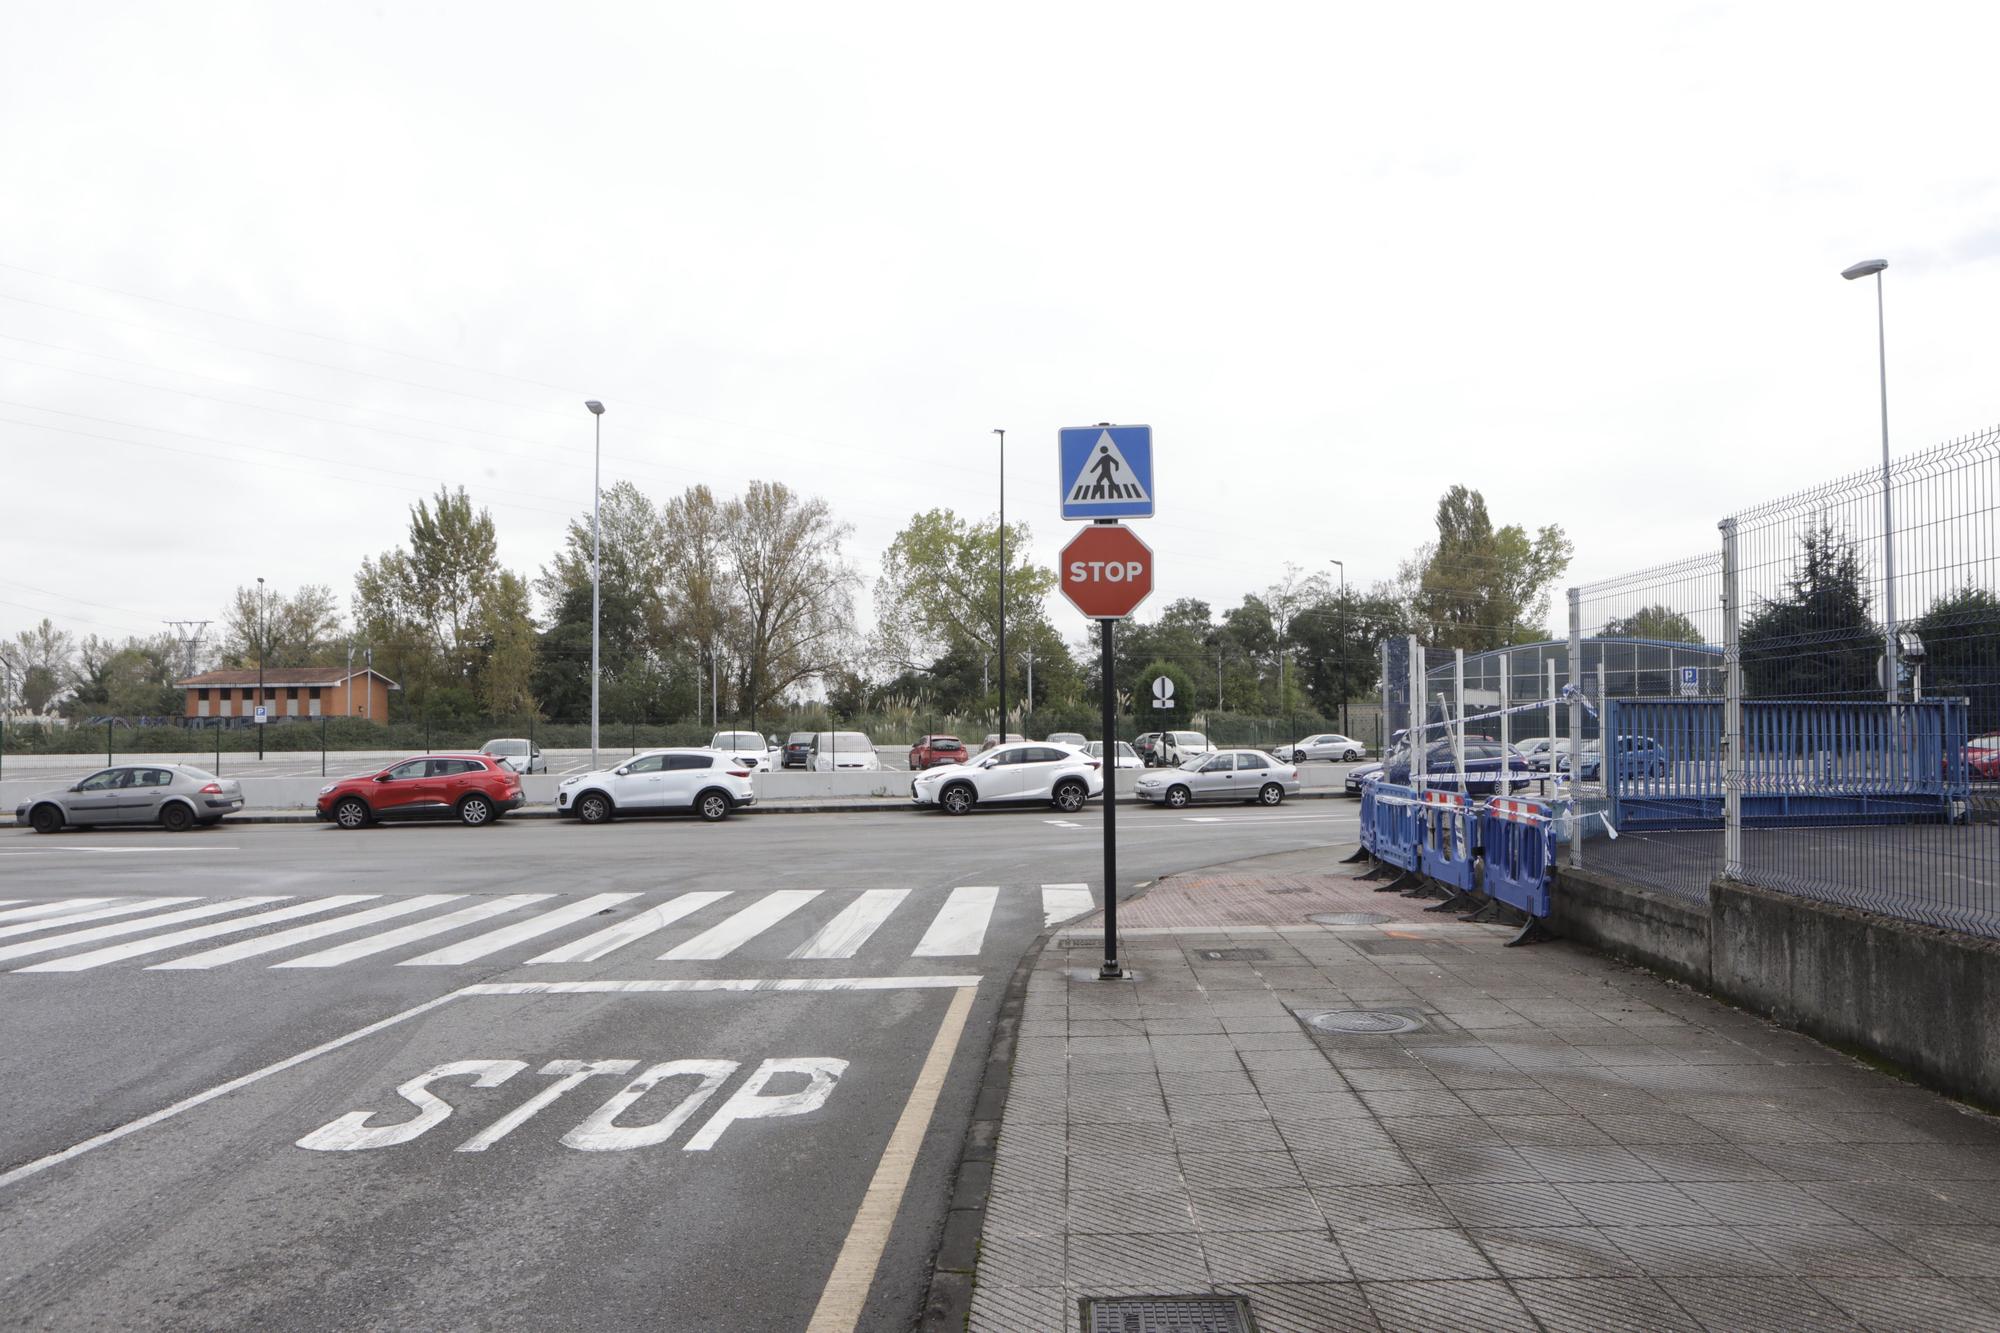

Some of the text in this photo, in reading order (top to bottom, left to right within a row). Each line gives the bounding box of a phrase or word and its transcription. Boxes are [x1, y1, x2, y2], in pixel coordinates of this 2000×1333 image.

[1070, 561, 1143, 583] STOP
[1685, 670, 1693, 682] P
[295, 1057, 850, 1152] STOP
